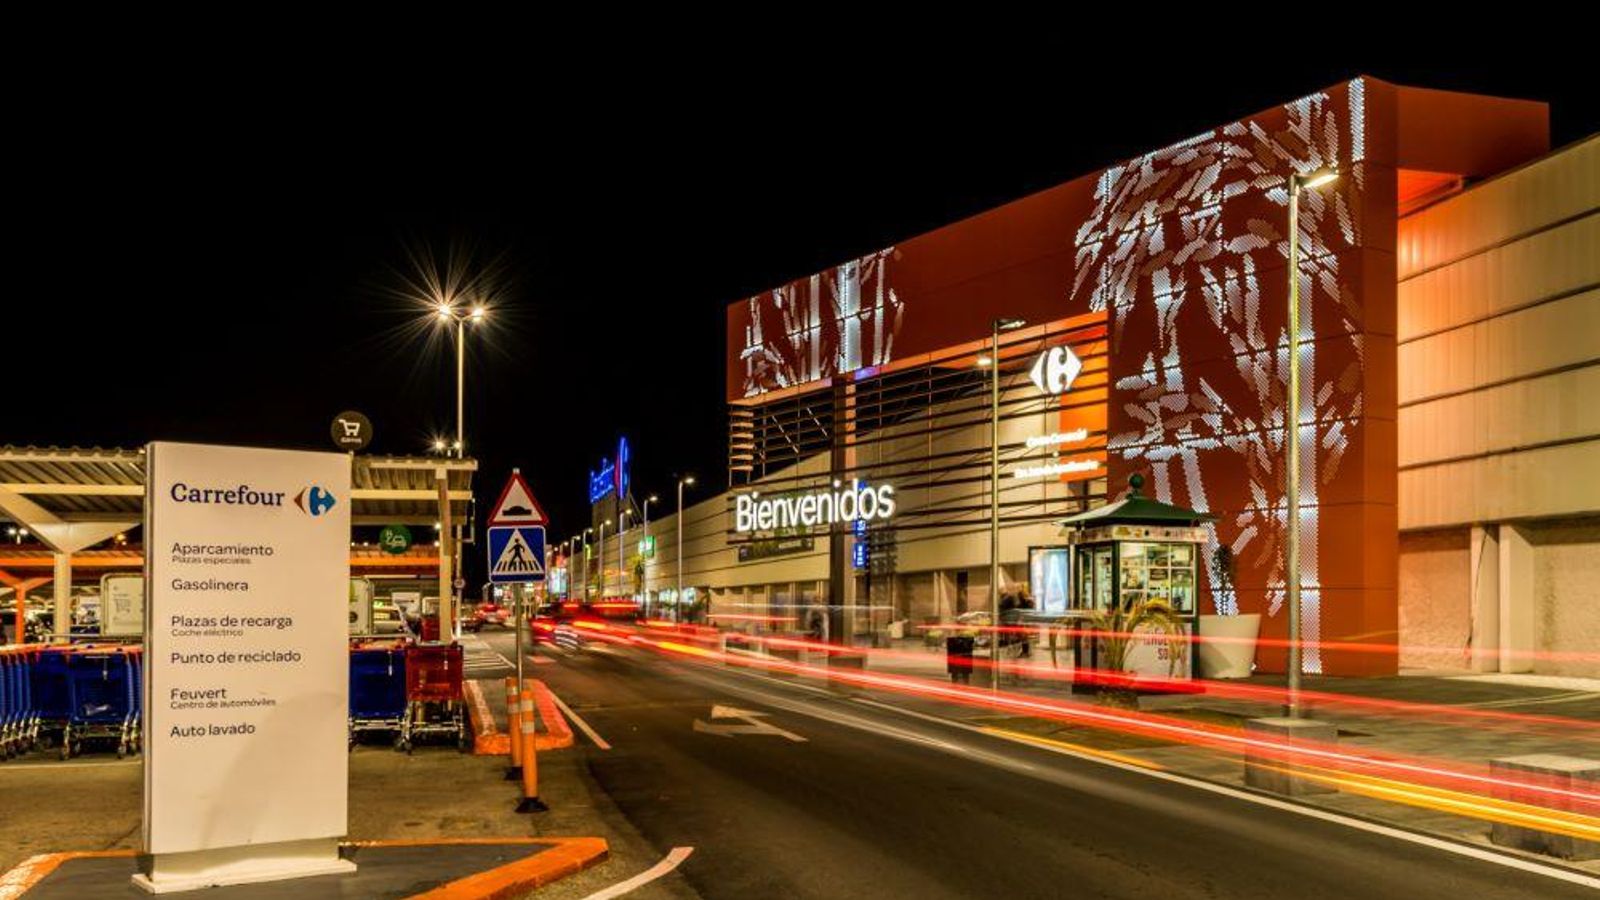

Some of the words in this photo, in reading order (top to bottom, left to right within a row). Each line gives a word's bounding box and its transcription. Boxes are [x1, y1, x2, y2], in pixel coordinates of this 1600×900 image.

[171, 482, 286, 507] Carrefour
[737, 478, 896, 532] Bienvenidos
[171, 542, 274, 556] Aparcamiento
[172, 555, 202, 564] Plazas
[203, 557, 252, 565] especiales
[171, 578, 249, 591] Gasolinera
[171, 615, 218, 627] Plazas
[219, 615, 239, 627] de
[240, 617, 293, 630] recarga
[171, 628, 202, 637] Coche
[171, 652, 215, 664] Punto
[216, 651, 236, 663] de
[238, 650, 302, 663] reciclado
[170, 687, 227, 700] Feuvert
[170, 700, 204, 709] Centro
[205, 700, 218, 708] de
[170, 725, 206, 738] Auto
[208, 723, 256, 735] lavado
